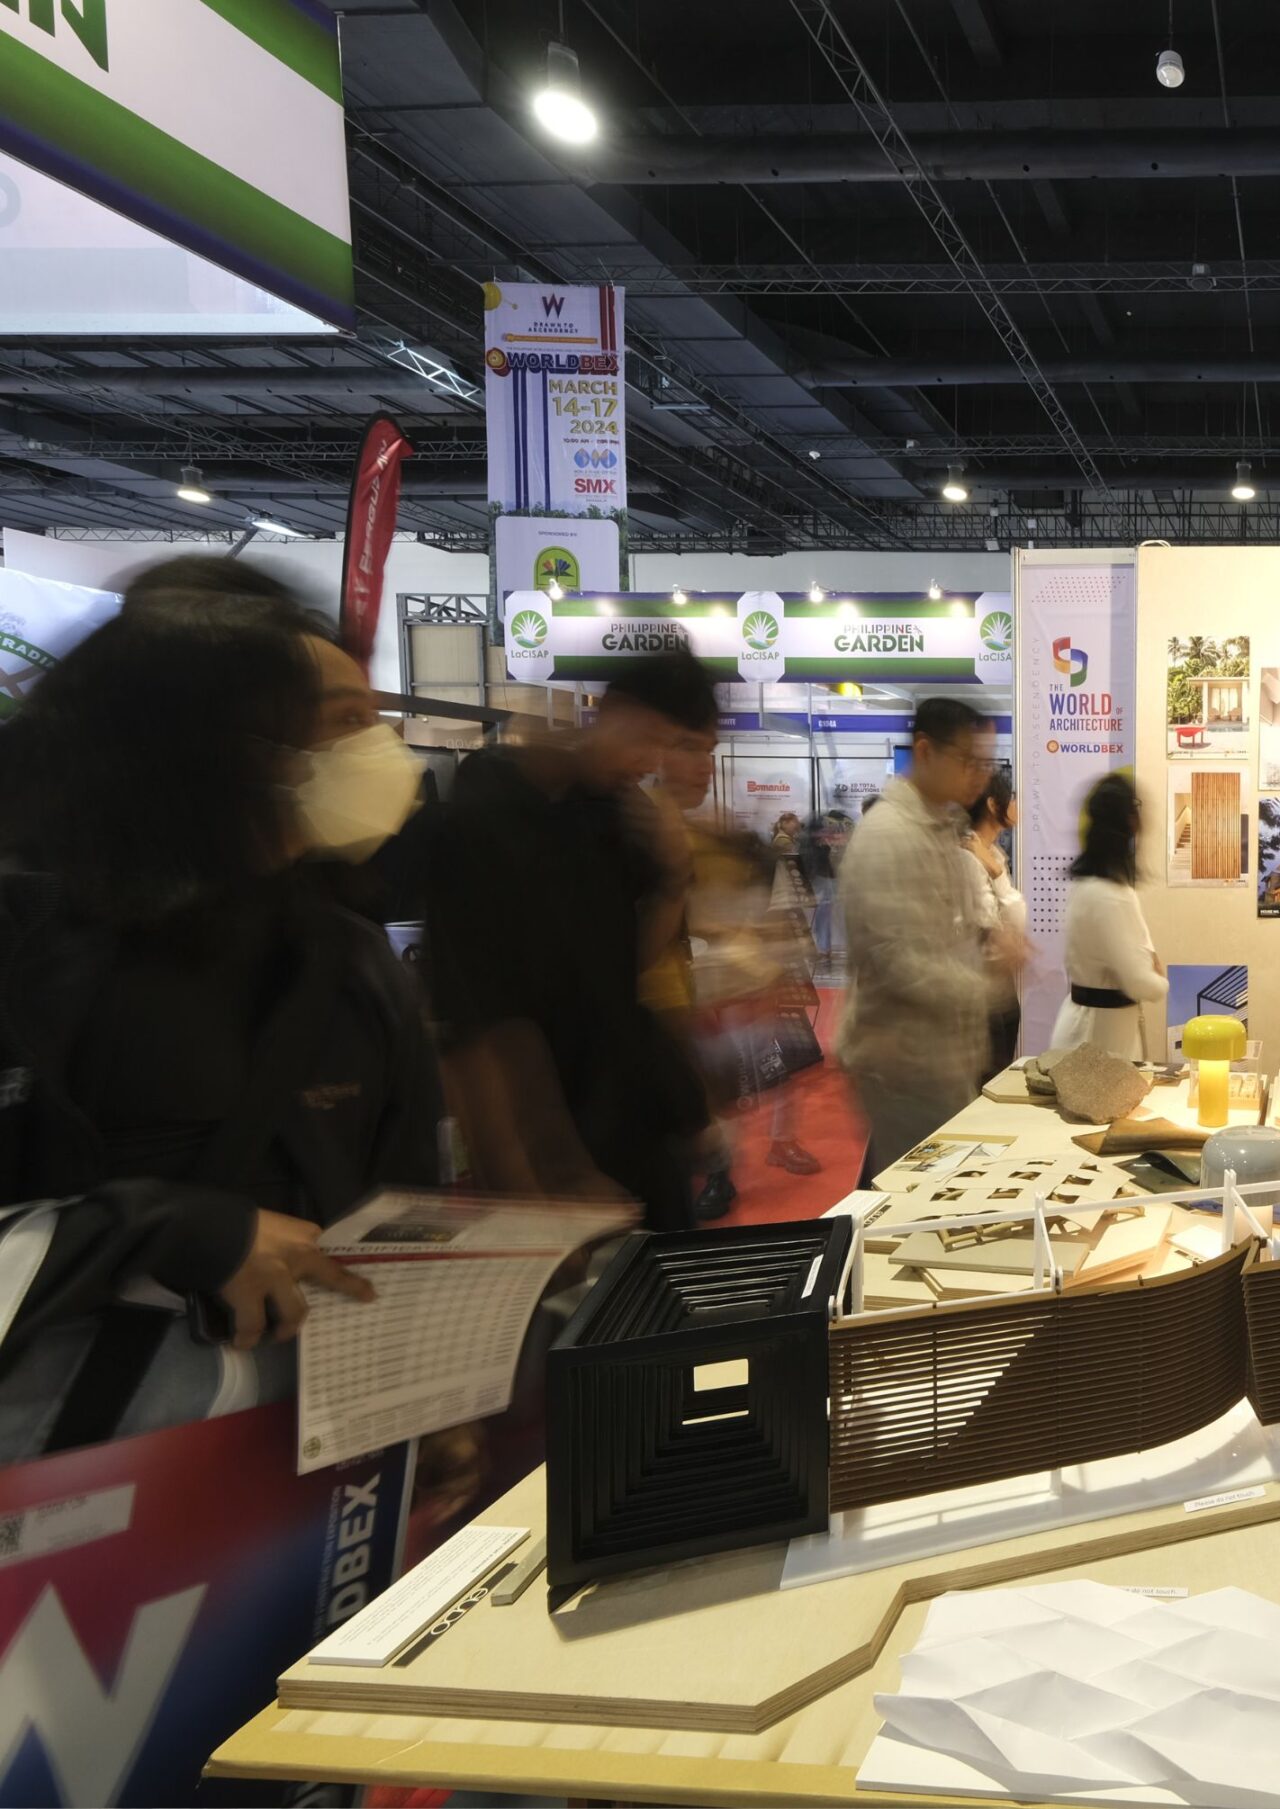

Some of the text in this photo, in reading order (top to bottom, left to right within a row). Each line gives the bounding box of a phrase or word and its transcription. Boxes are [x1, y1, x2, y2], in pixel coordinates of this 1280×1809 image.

[507, 352, 619, 374] WORLDBEX
[549, 380, 618, 395] MARCH
[552, 397, 618, 417] 14-17
[570, 419, 618, 435] 2024
[574, 479, 616, 494] SMX
[610, 624, 678, 633] PHILIPPINE
[844, 624, 913, 634] PHILIPPINE
[602, 634, 690, 651] GARDEN
[834, 635, 924, 652] GARDEN
[510, 650, 549, 659] LaCISAP
[741, 651, 780, 660] LaCISAP
[1049, 693, 1112, 716] WORLD
[1049, 719, 1123, 731] ARCHITECTURE
[1060, 744, 1124, 753] WORLDBEX
